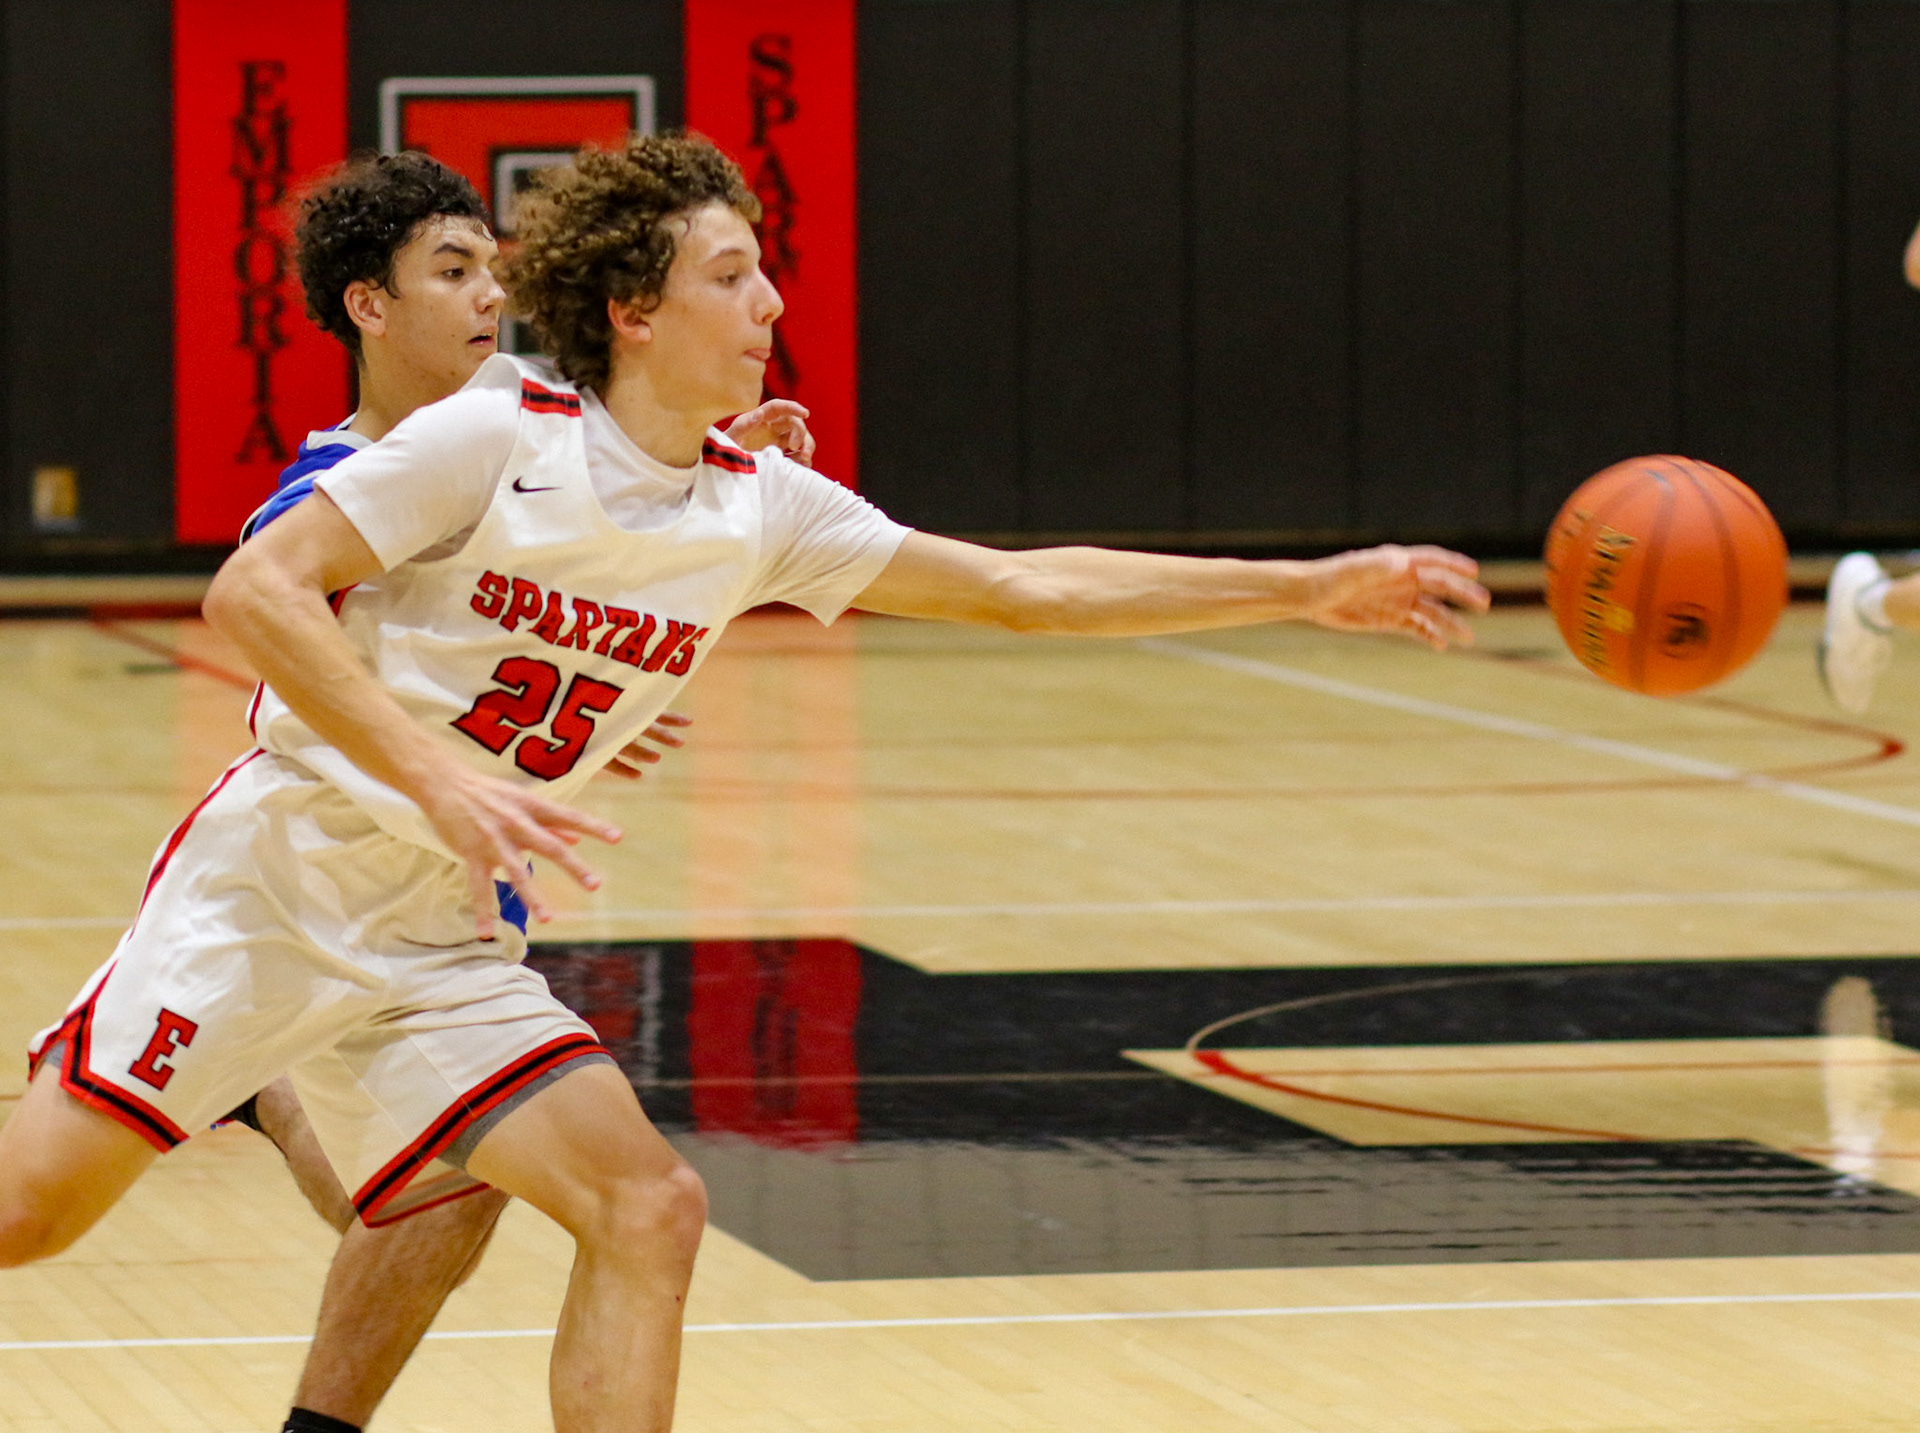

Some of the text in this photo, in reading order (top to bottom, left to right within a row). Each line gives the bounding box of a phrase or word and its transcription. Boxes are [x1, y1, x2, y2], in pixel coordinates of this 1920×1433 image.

[230, 61, 293, 464] EMPORIA
[470, 570, 710, 677] SPARTANS
[449, 656, 626, 782] 25
[128, 1007, 199, 1091] E
